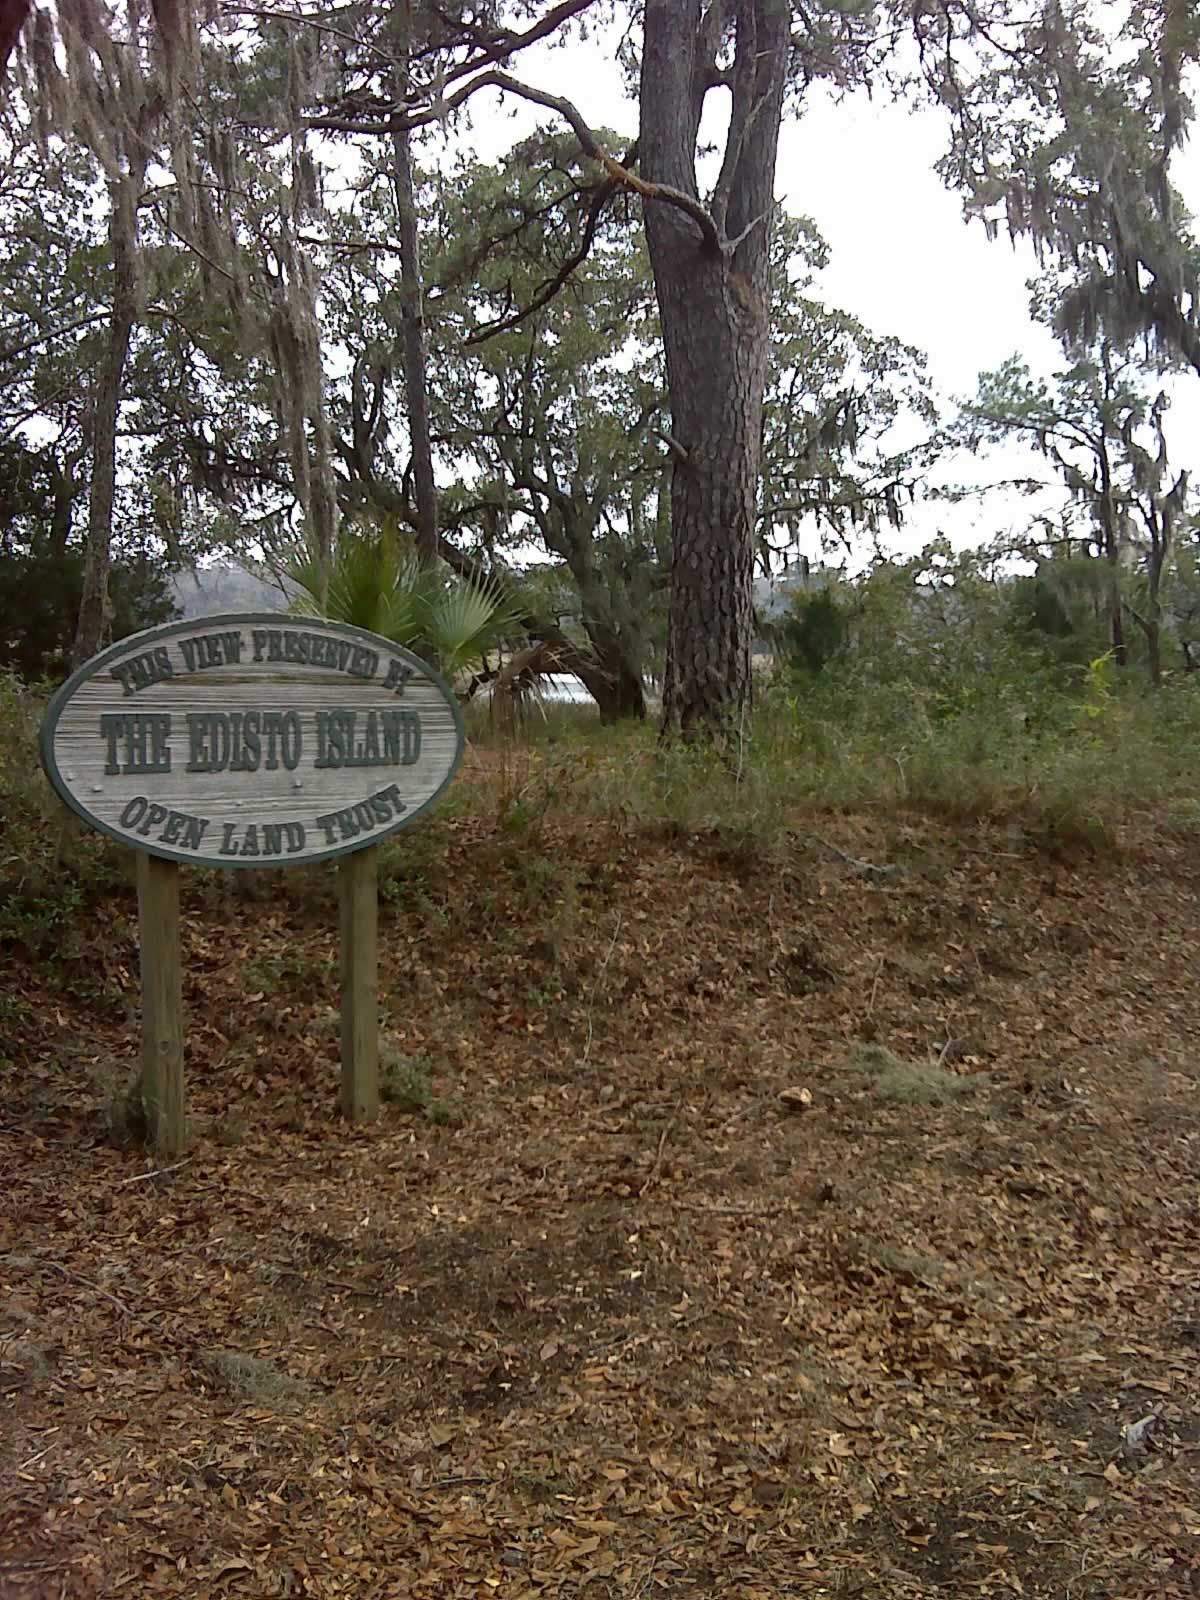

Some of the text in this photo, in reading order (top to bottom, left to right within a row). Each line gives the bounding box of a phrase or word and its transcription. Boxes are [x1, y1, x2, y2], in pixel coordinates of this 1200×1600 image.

[109, 630, 414, 696] THIS VIEW PRESERVED BY
[101, 710, 422, 775] THE EDISTO ISLAND
[120, 784, 407, 856] OPEN LAND TRUST
